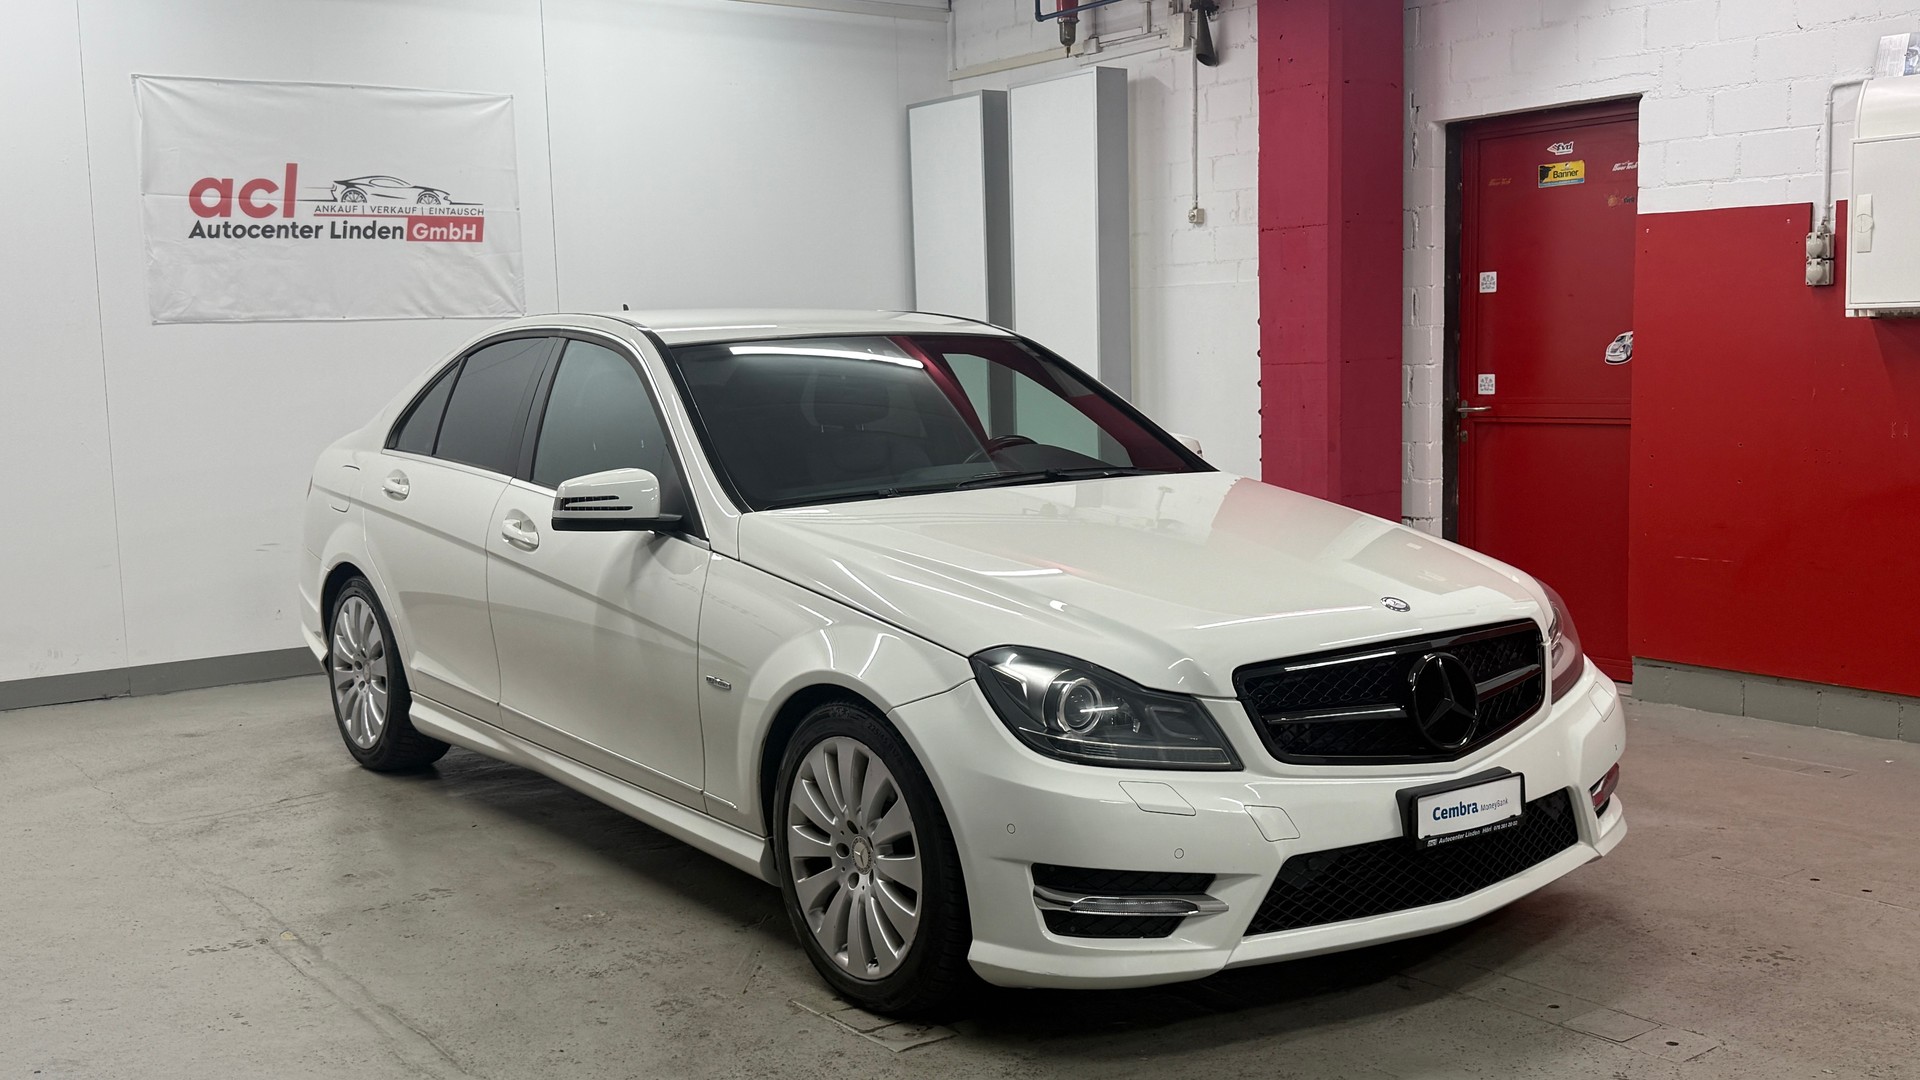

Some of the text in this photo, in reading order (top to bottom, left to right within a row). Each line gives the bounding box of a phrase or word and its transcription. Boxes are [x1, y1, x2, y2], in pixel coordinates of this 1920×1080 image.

[1553, 169, 1579, 179] Banner
[189, 163, 298, 219] acl
[314, 205, 484, 216] ANKAUF VERKAUF EINTAUSCH
[188, 219, 477, 241] Autocenter Linden GmbH
[1432, 797, 1508, 821] Cembra MoneyBank
[1438, 833, 1465, 844] Autocenter
[1465, 829, 1481, 838] Linden
